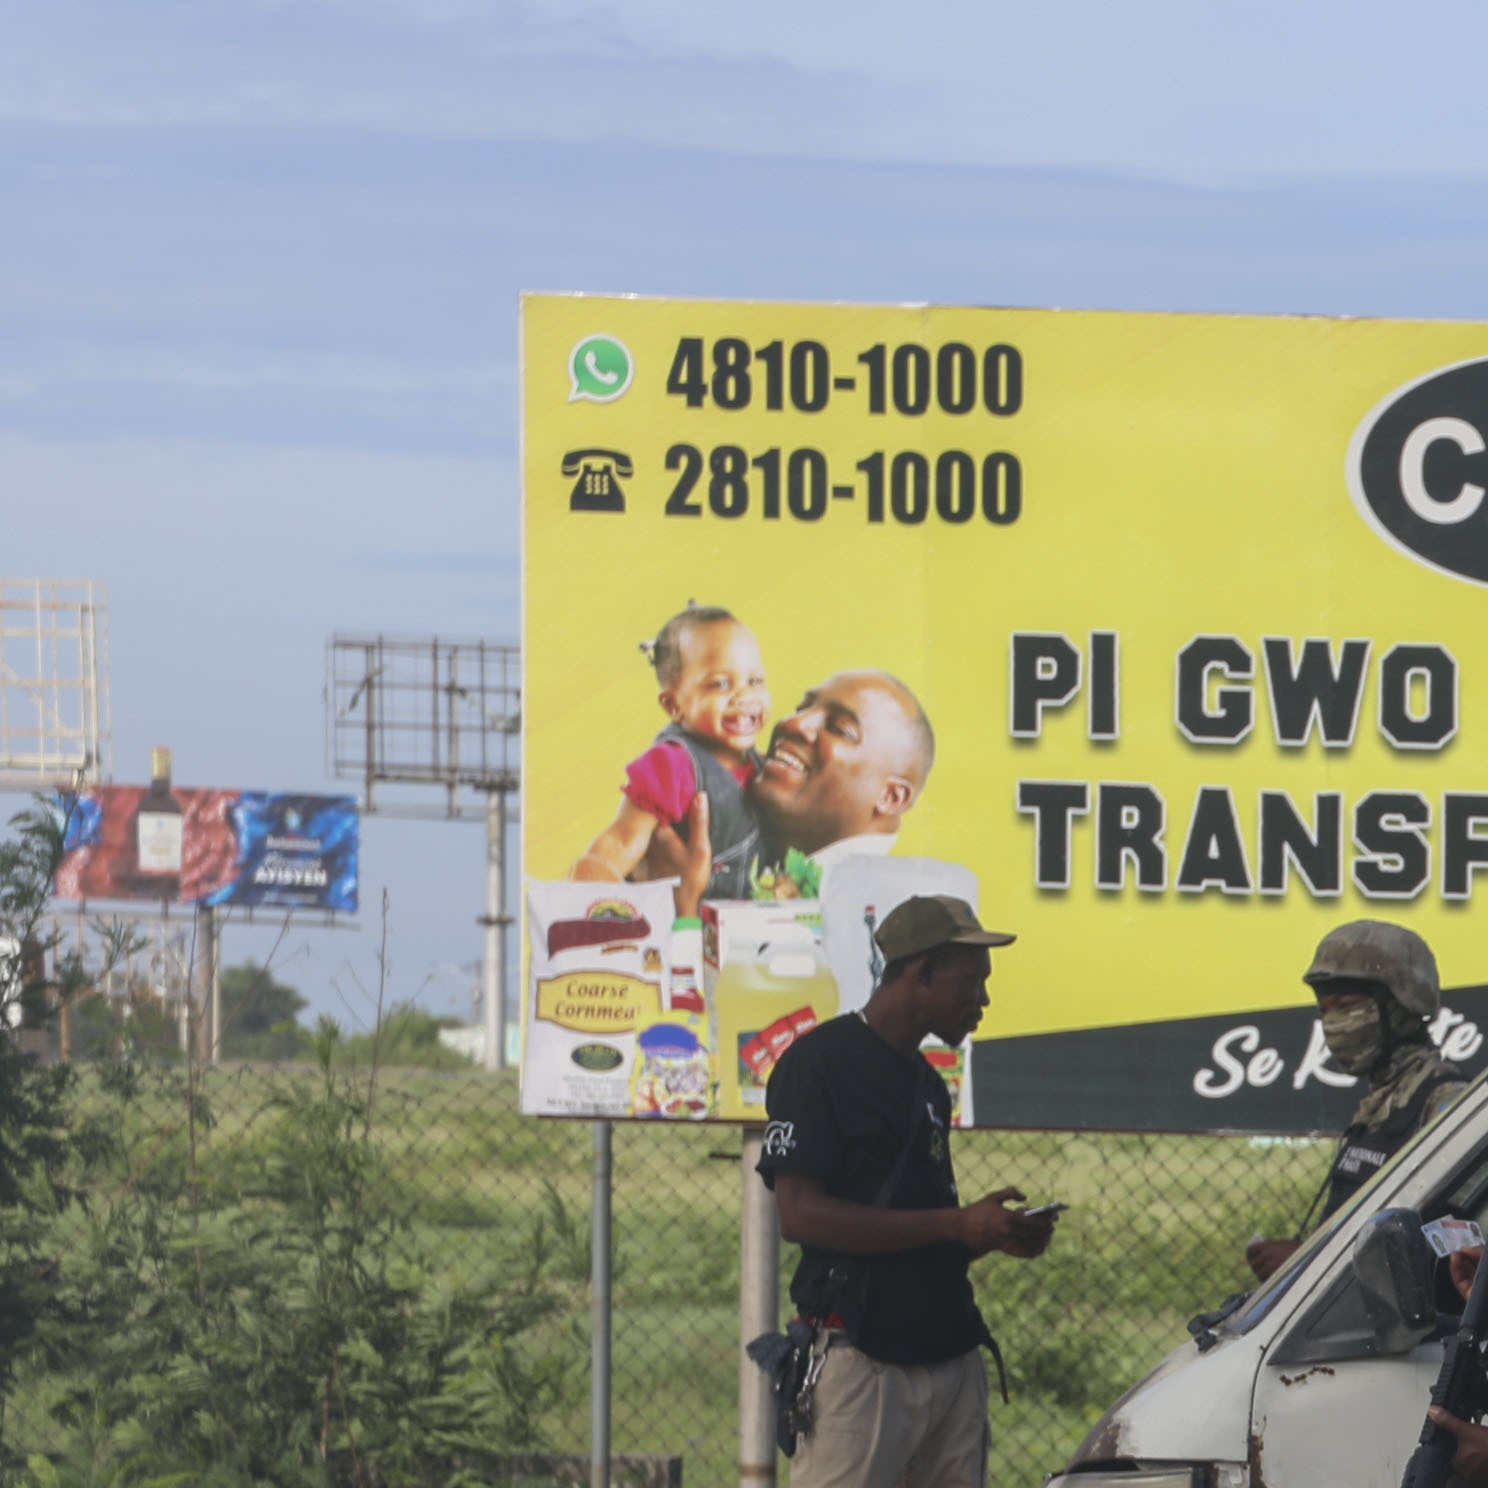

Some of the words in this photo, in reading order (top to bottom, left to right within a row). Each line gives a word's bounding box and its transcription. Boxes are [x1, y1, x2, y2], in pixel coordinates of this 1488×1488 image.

[666, 337, 1023, 416] 4810-1000
[664, 442, 1022, 525] 2810-1000
[1010, 630, 1119, 740] PI
[1175, 634, 1459, 750] GWO
[566, 981, 629, 998] Coarse
[1193, 1025, 1284, 1098] Se
